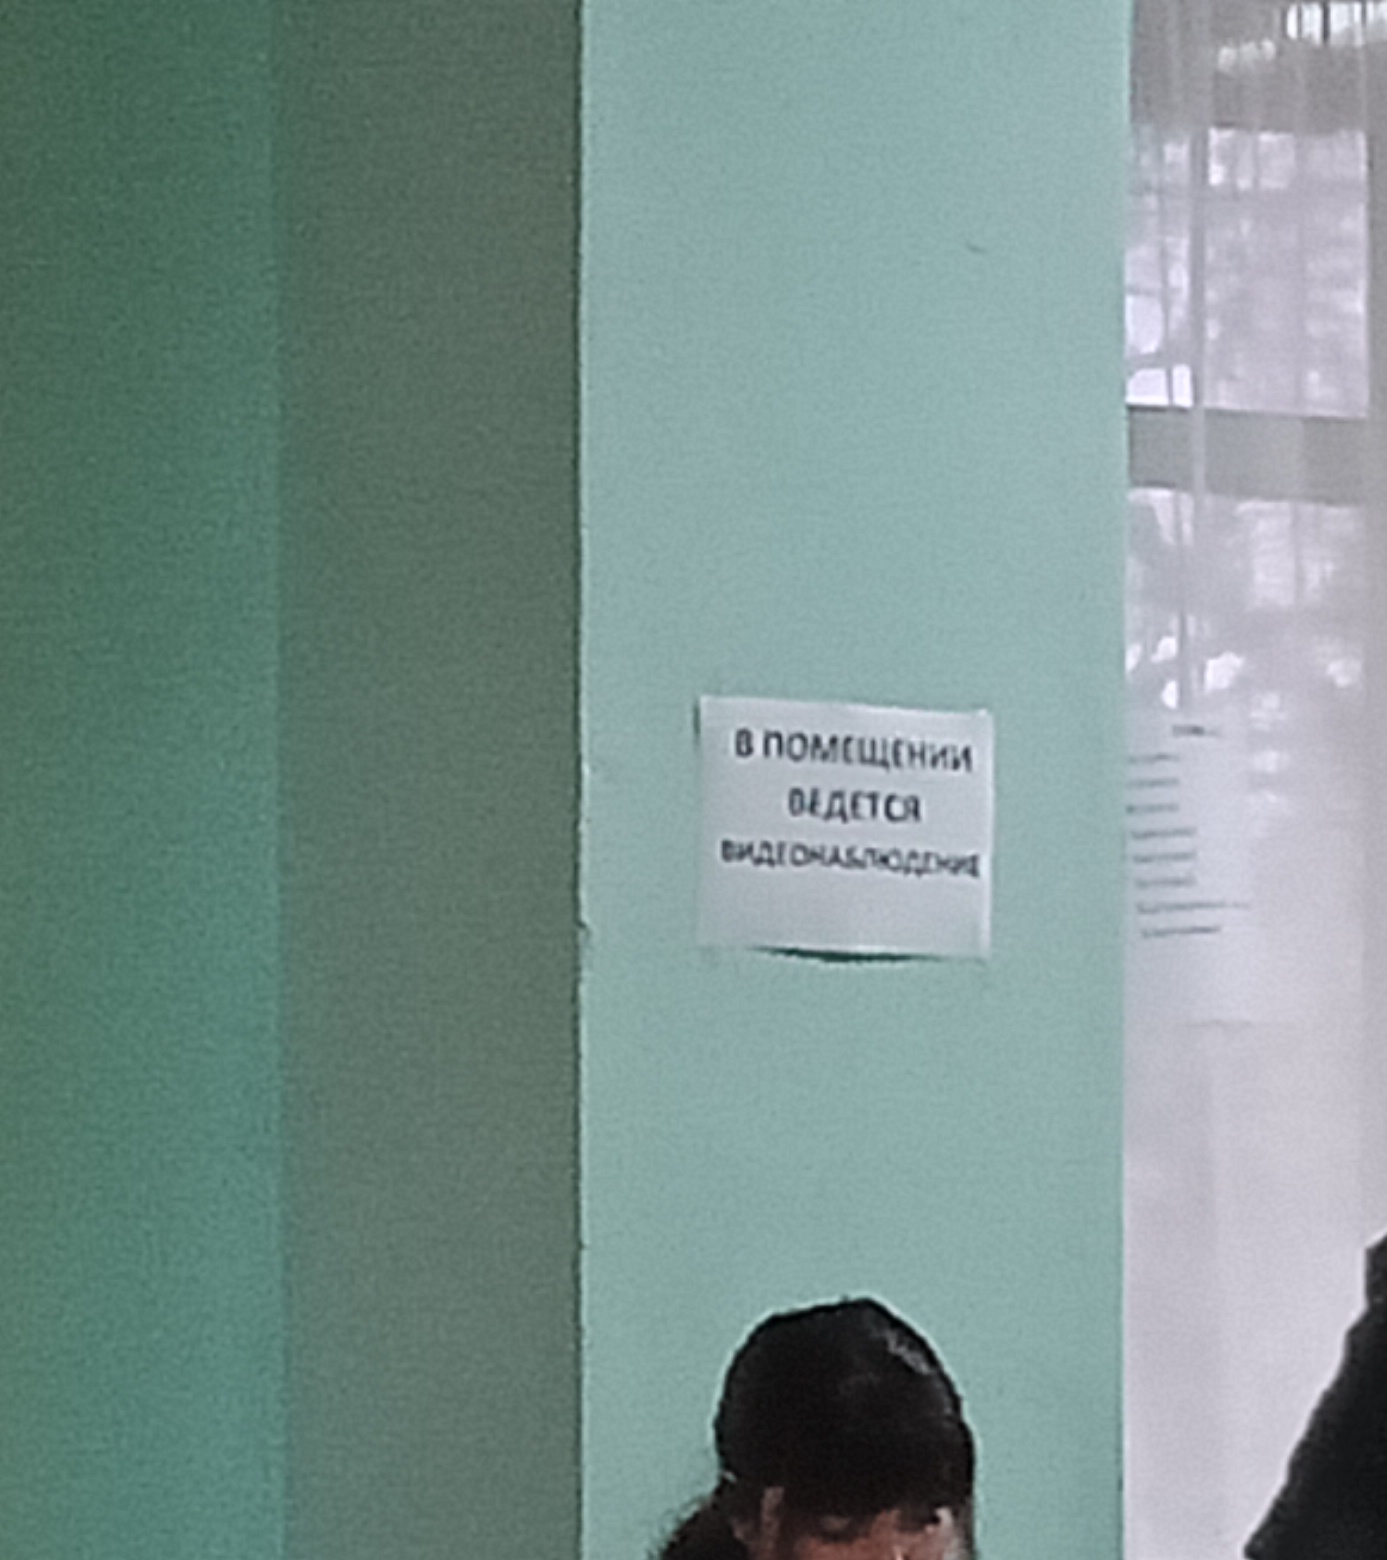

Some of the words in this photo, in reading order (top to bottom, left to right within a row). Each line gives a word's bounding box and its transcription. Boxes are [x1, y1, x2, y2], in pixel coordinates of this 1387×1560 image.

[735, 728, 754, 758] В
[763, 731, 973, 772] ПОМЕЩЕНИИ
[788, 787, 921, 823] ВЕДЕТСЯ
[720, 839, 980, 878] ВИДЕОНАБЛЮДЕНИЕ
